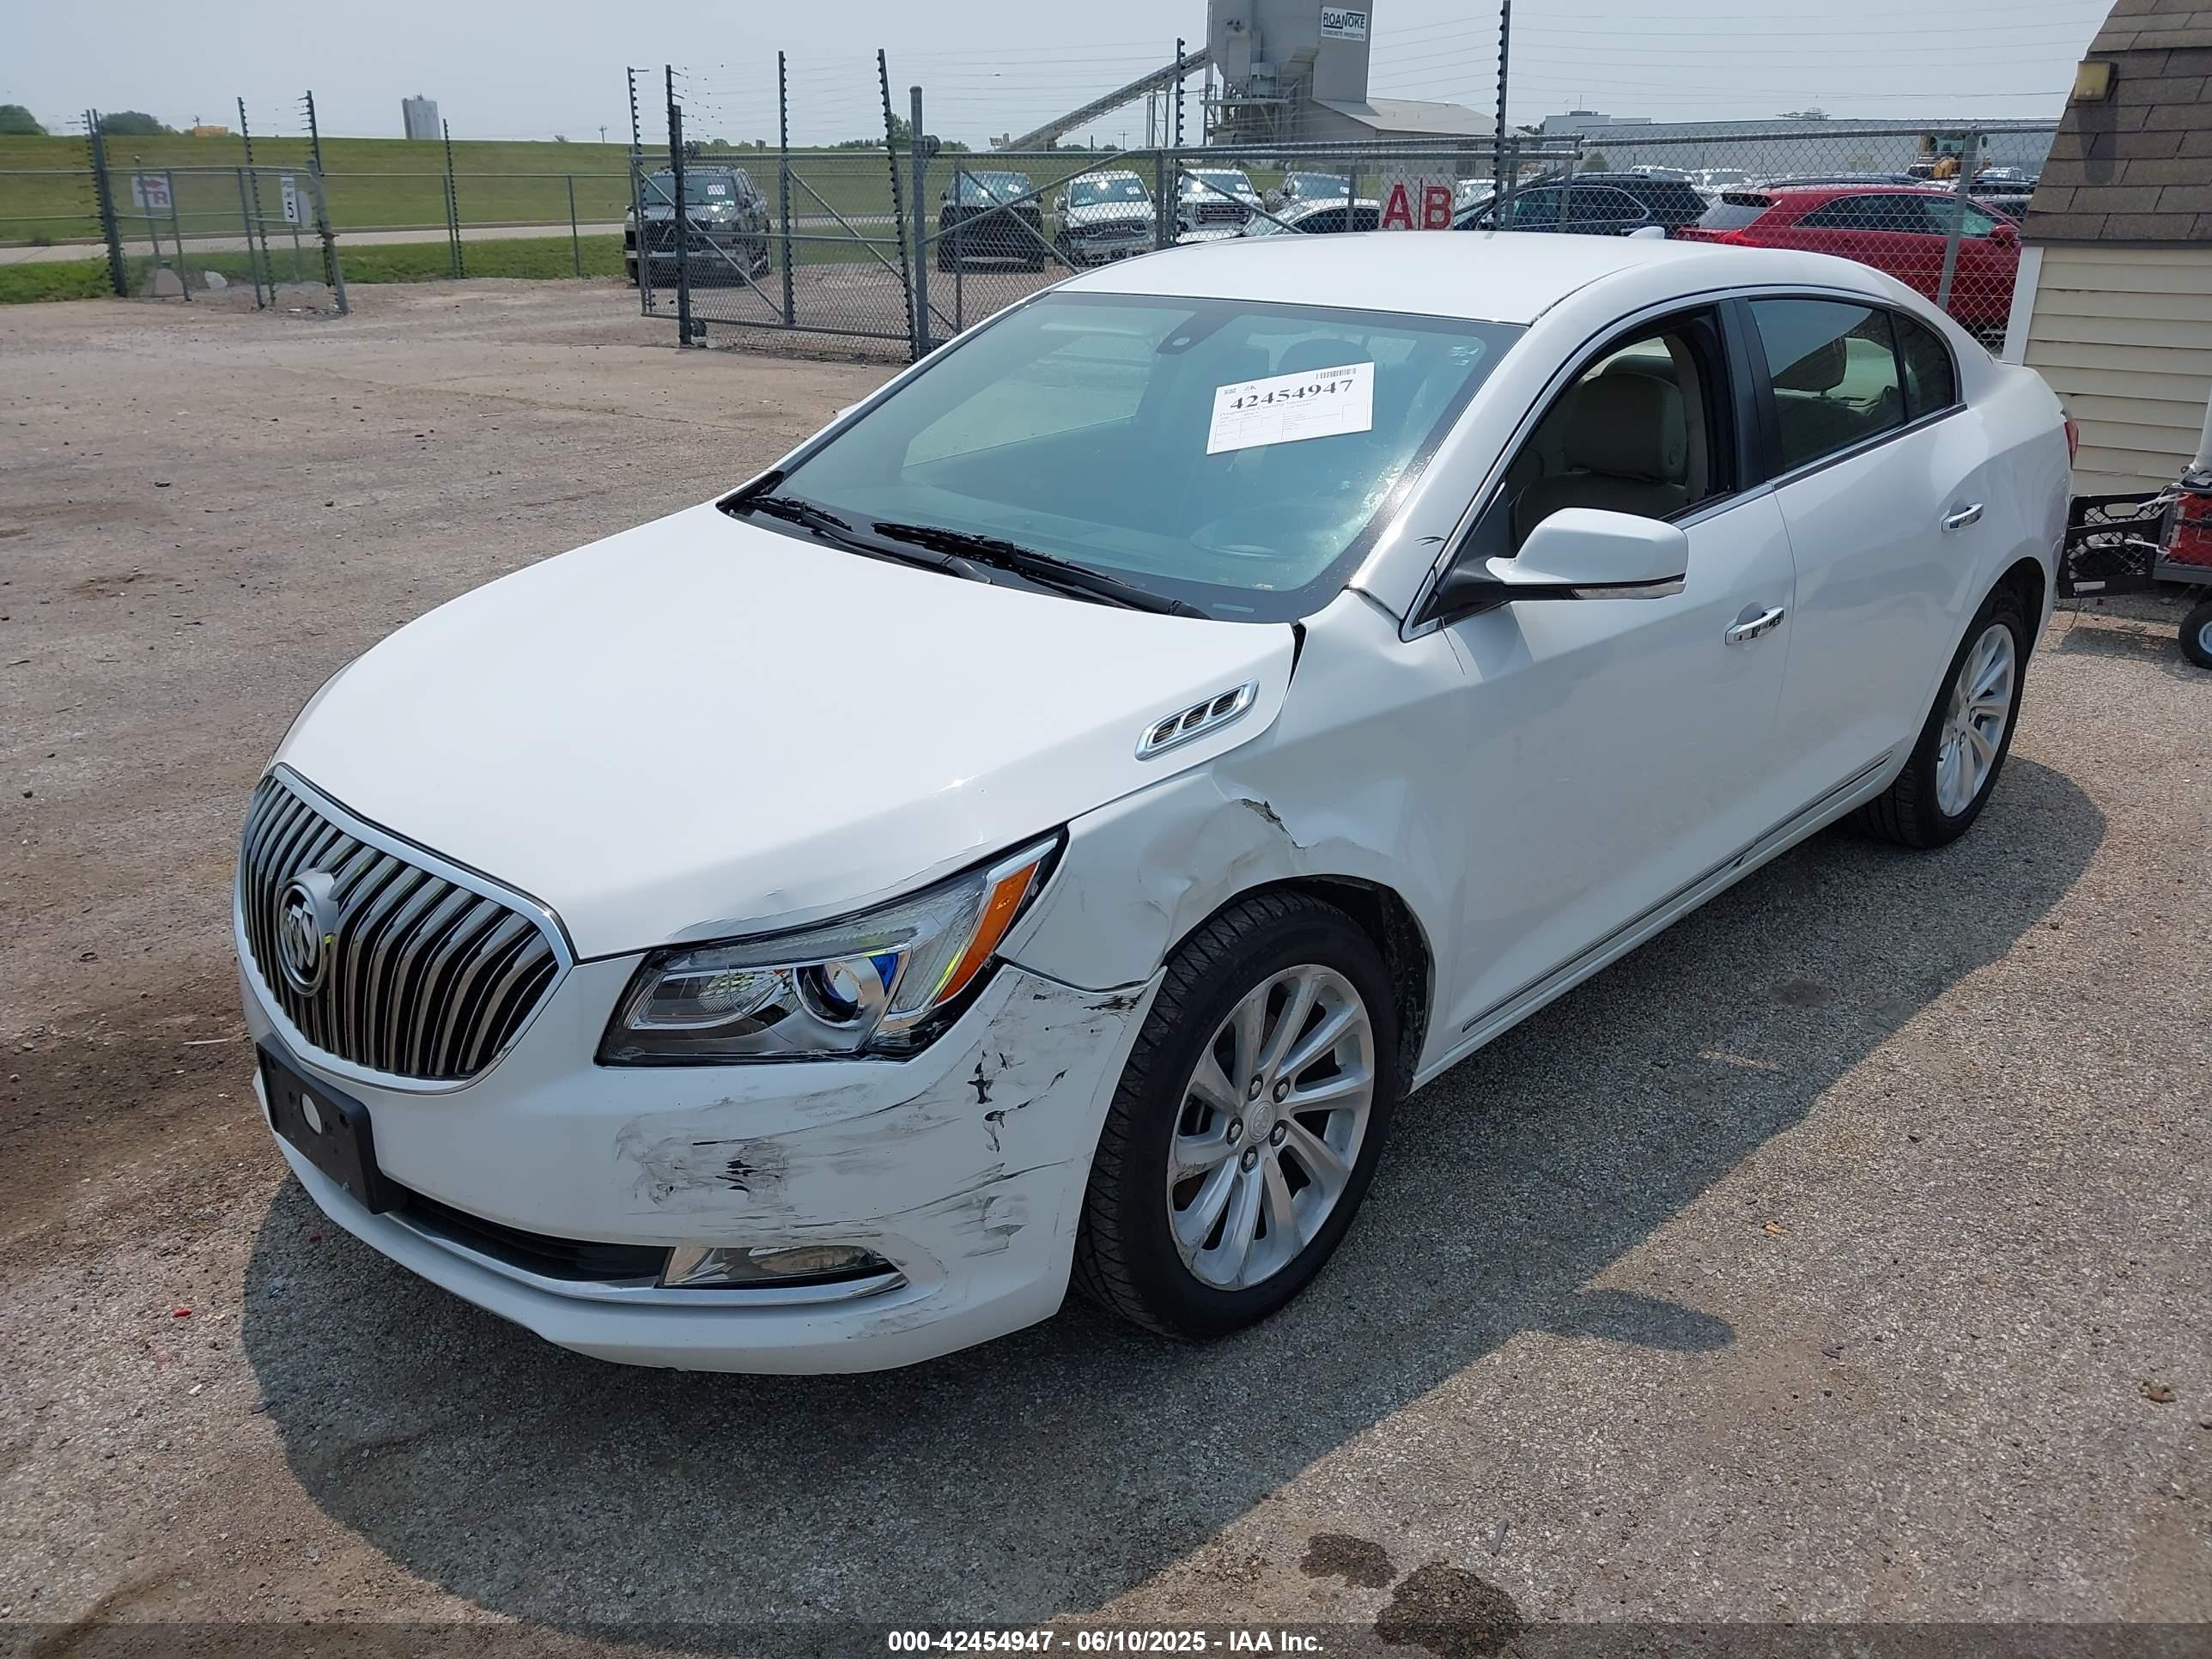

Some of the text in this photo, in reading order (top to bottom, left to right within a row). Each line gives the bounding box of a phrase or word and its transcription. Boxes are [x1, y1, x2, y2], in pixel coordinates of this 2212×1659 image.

[1323, 12, 1365, 29] ROANOKE
[287, 201, 295, 219] 5
[1230, 379, 1354, 410] 42454947
